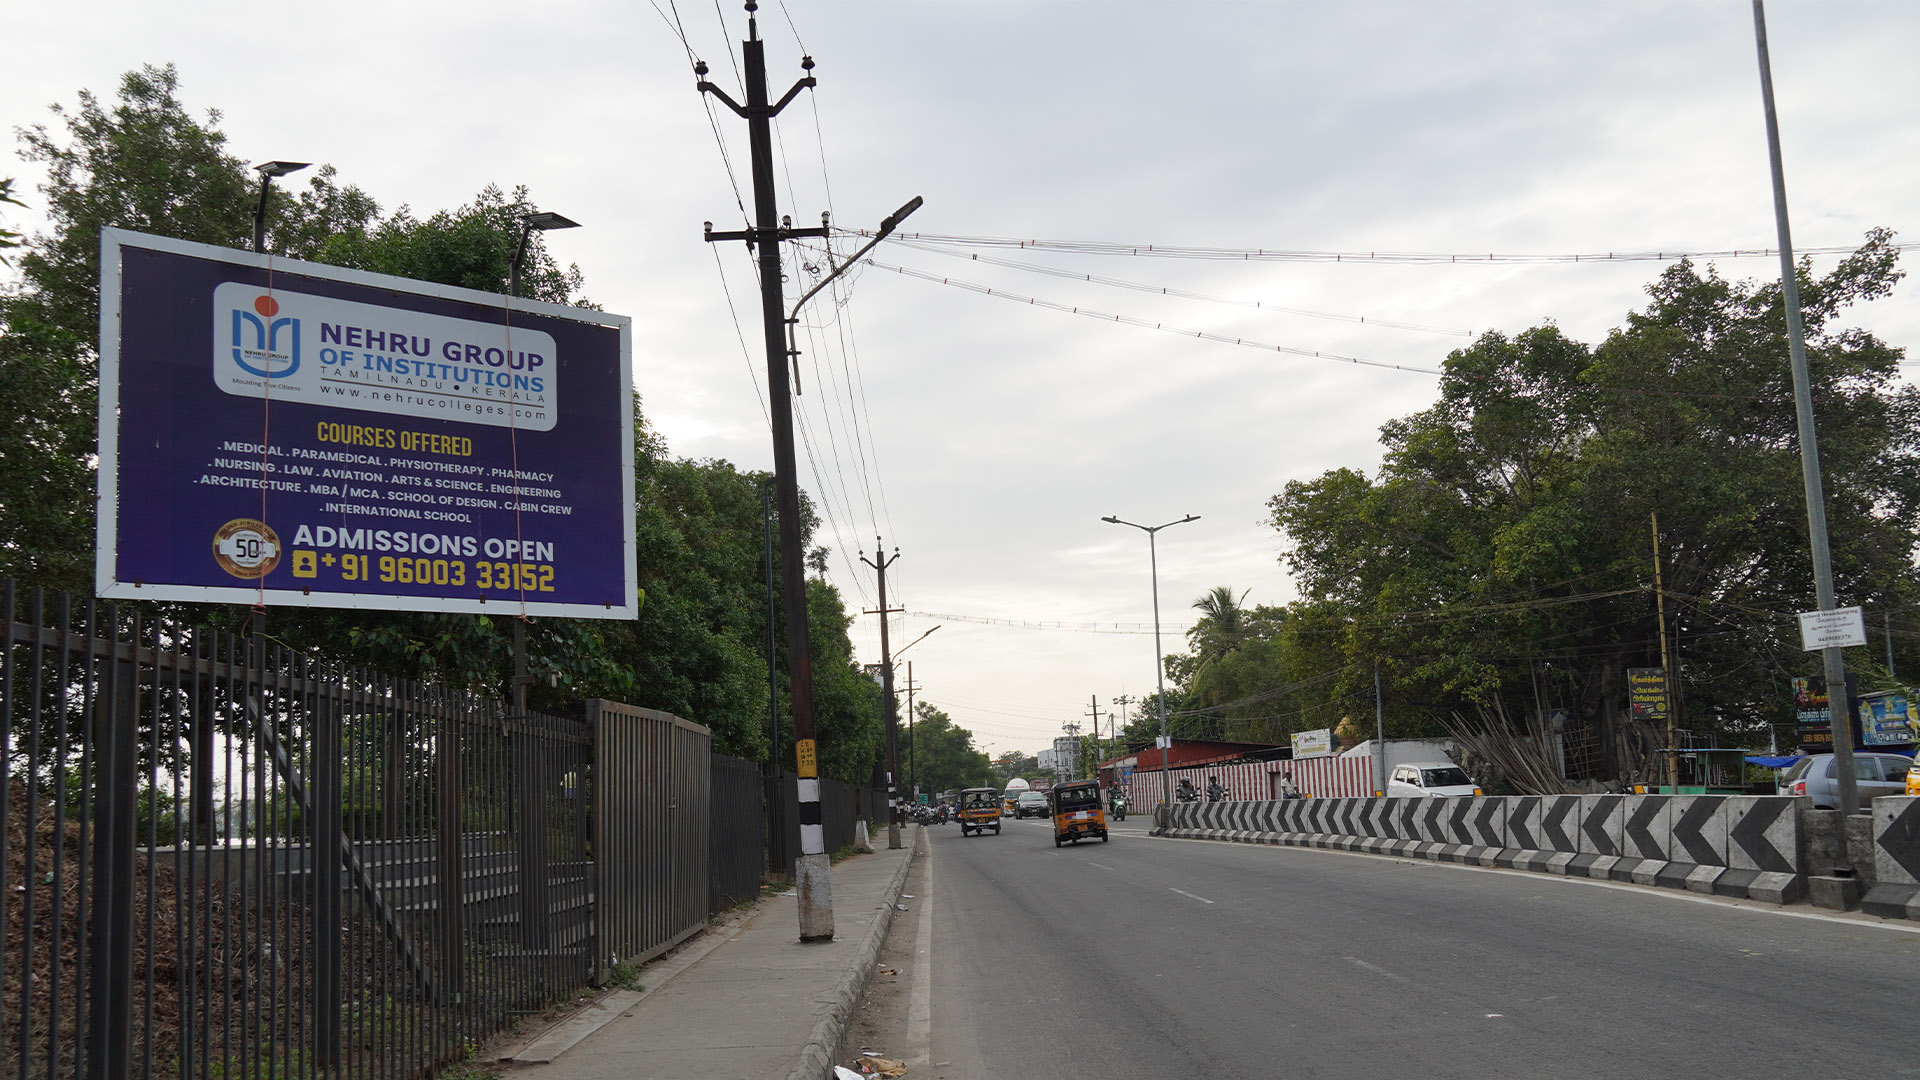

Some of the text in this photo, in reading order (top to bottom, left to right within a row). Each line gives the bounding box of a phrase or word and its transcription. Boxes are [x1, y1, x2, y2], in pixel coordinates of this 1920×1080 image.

[321, 322, 544, 372] NEHRU GROUP
[232, 378, 262, 387] Moulding
[278, 383, 301, 391] Citizens
[320, 348, 544, 393] OF INSTITUTIONS
[320, 366, 545, 403] TAMILNADU KERALA
[320, 385, 546, 420] www.nehrucolleges.com
[317, 421, 472, 457] COURSES OFFERED
[214, 457, 562, 499] NURSING LAW AVIATION ARTS & SCIENCE ENGINEERING
[224, 441, 554, 483] MEDICAL PARAMEDICAL PHYSIOTHERAPY PHARMACY
[200, 474, 302, 493] ARCHITECTURE
[310, 483, 340, 496] MBA
[350, 487, 380, 500] MCA
[387, 490, 437, 504] SCHOOL
[438, 494, 455, 505] OF
[455, 496, 498, 510] DESIGN
[504, 500, 539, 513] CABIN
[540, 504, 573, 515] CREW
[325, 502, 473, 524] INTERNATIONAL SCHOOL
[292, 524, 554, 562] ADMISSIONS OPEN
[379, 556, 466, 586] 96003
[476, 561, 555, 592] 33152
